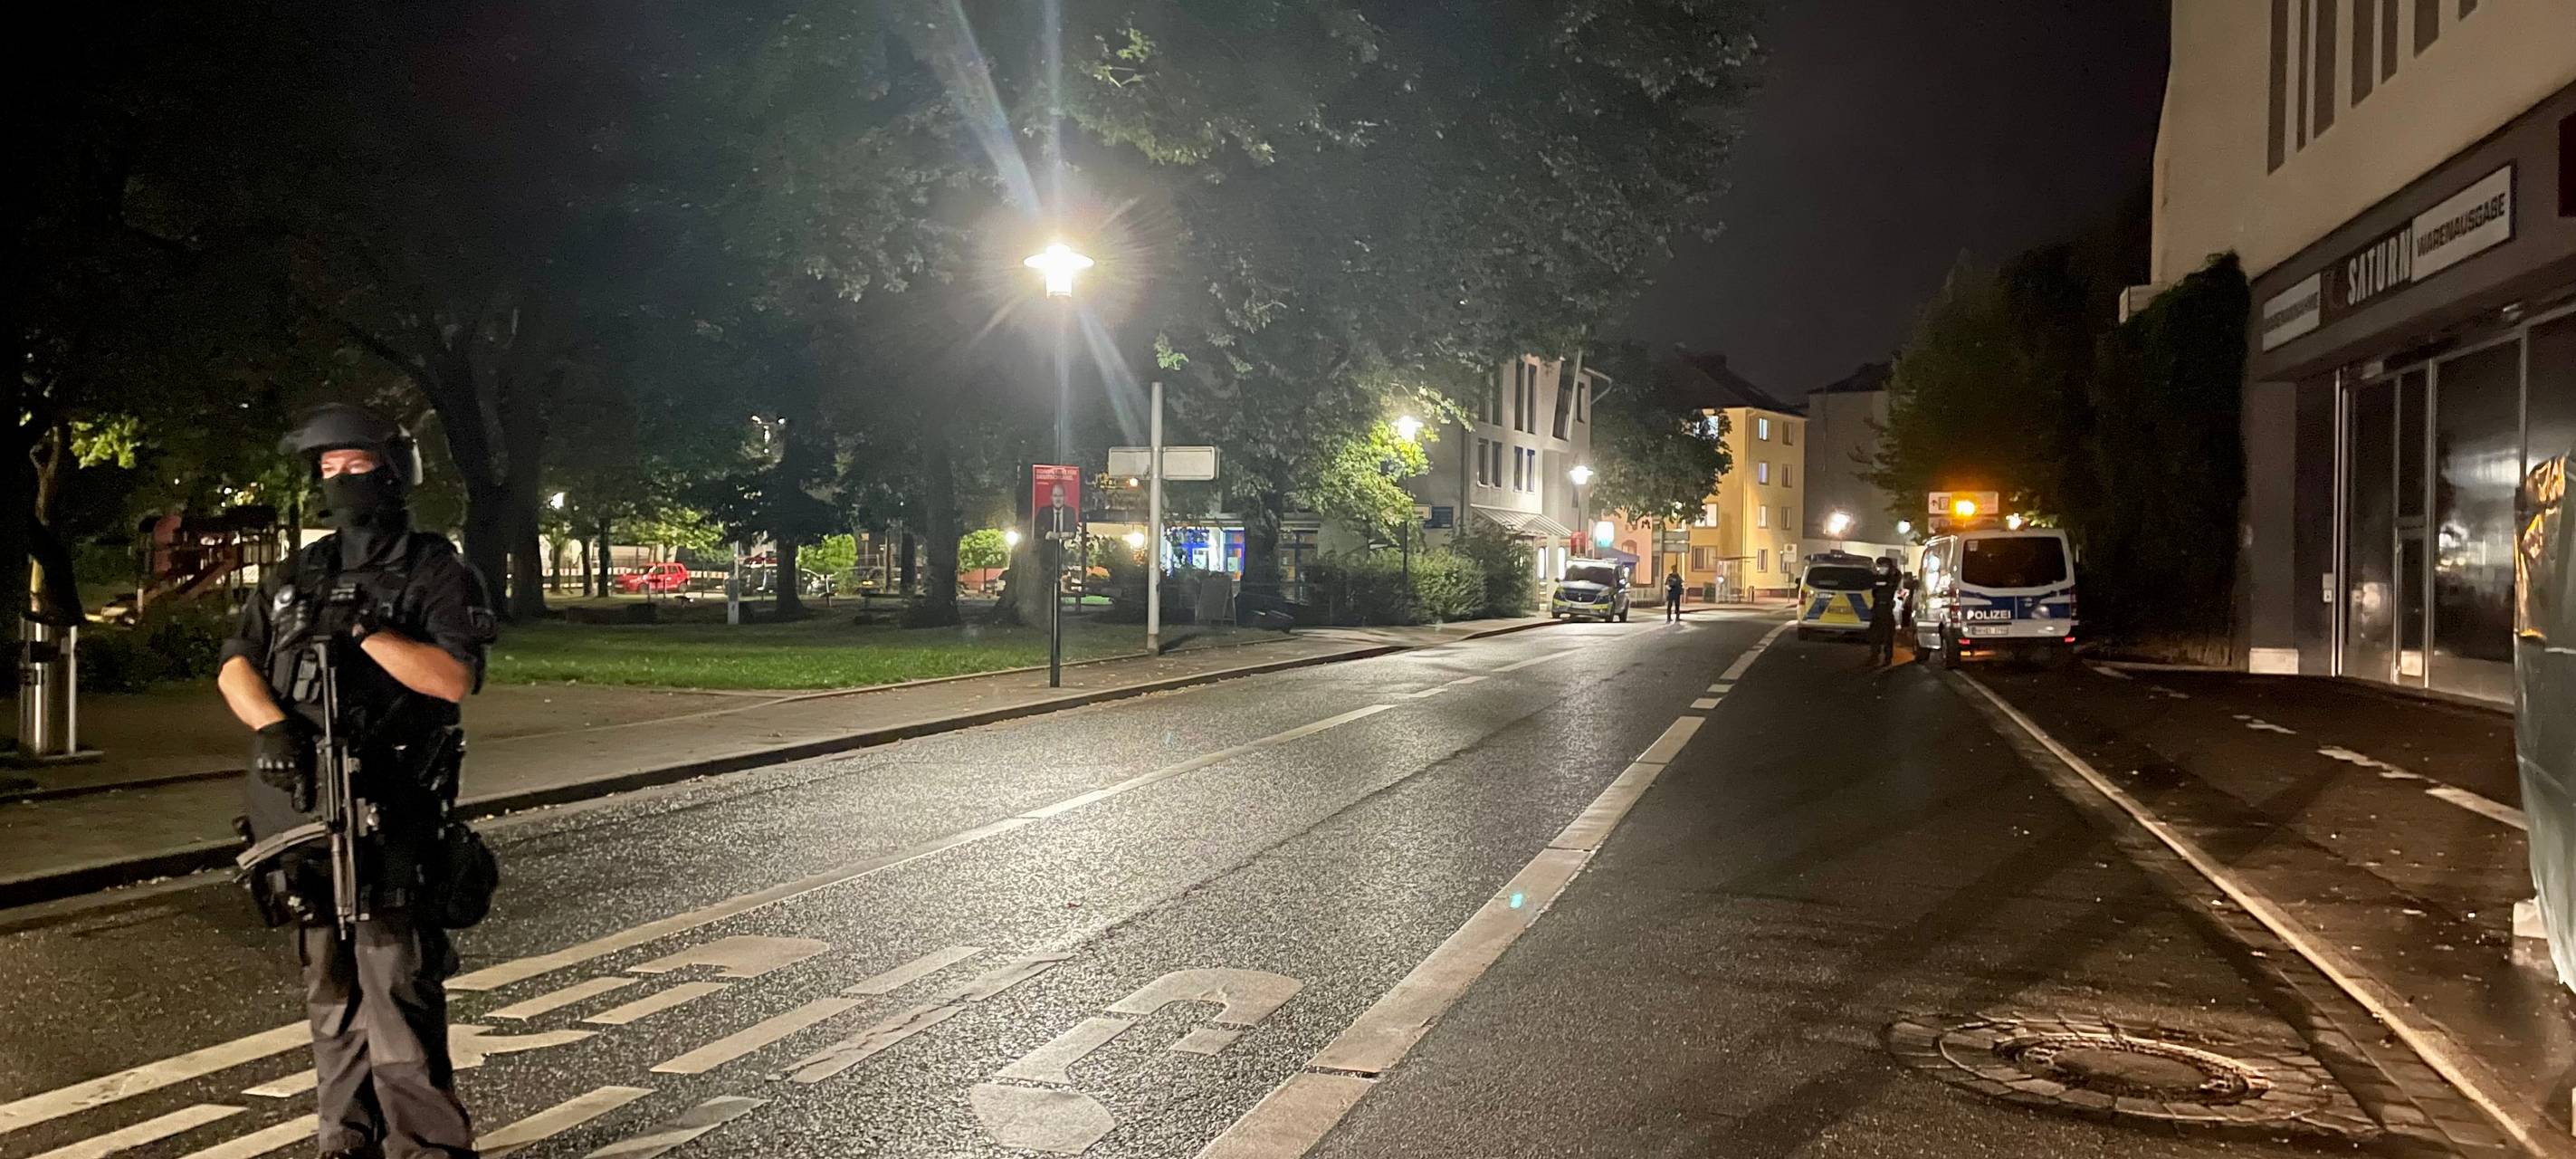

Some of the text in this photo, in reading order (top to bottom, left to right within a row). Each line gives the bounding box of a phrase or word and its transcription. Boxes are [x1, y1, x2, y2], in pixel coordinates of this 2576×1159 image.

[2418, 192, 2505, 257] WARENAUSGABE
[2348, 228, 2411, 306] SATURN
[1967, 609, 2011, 620] POLIZEI
